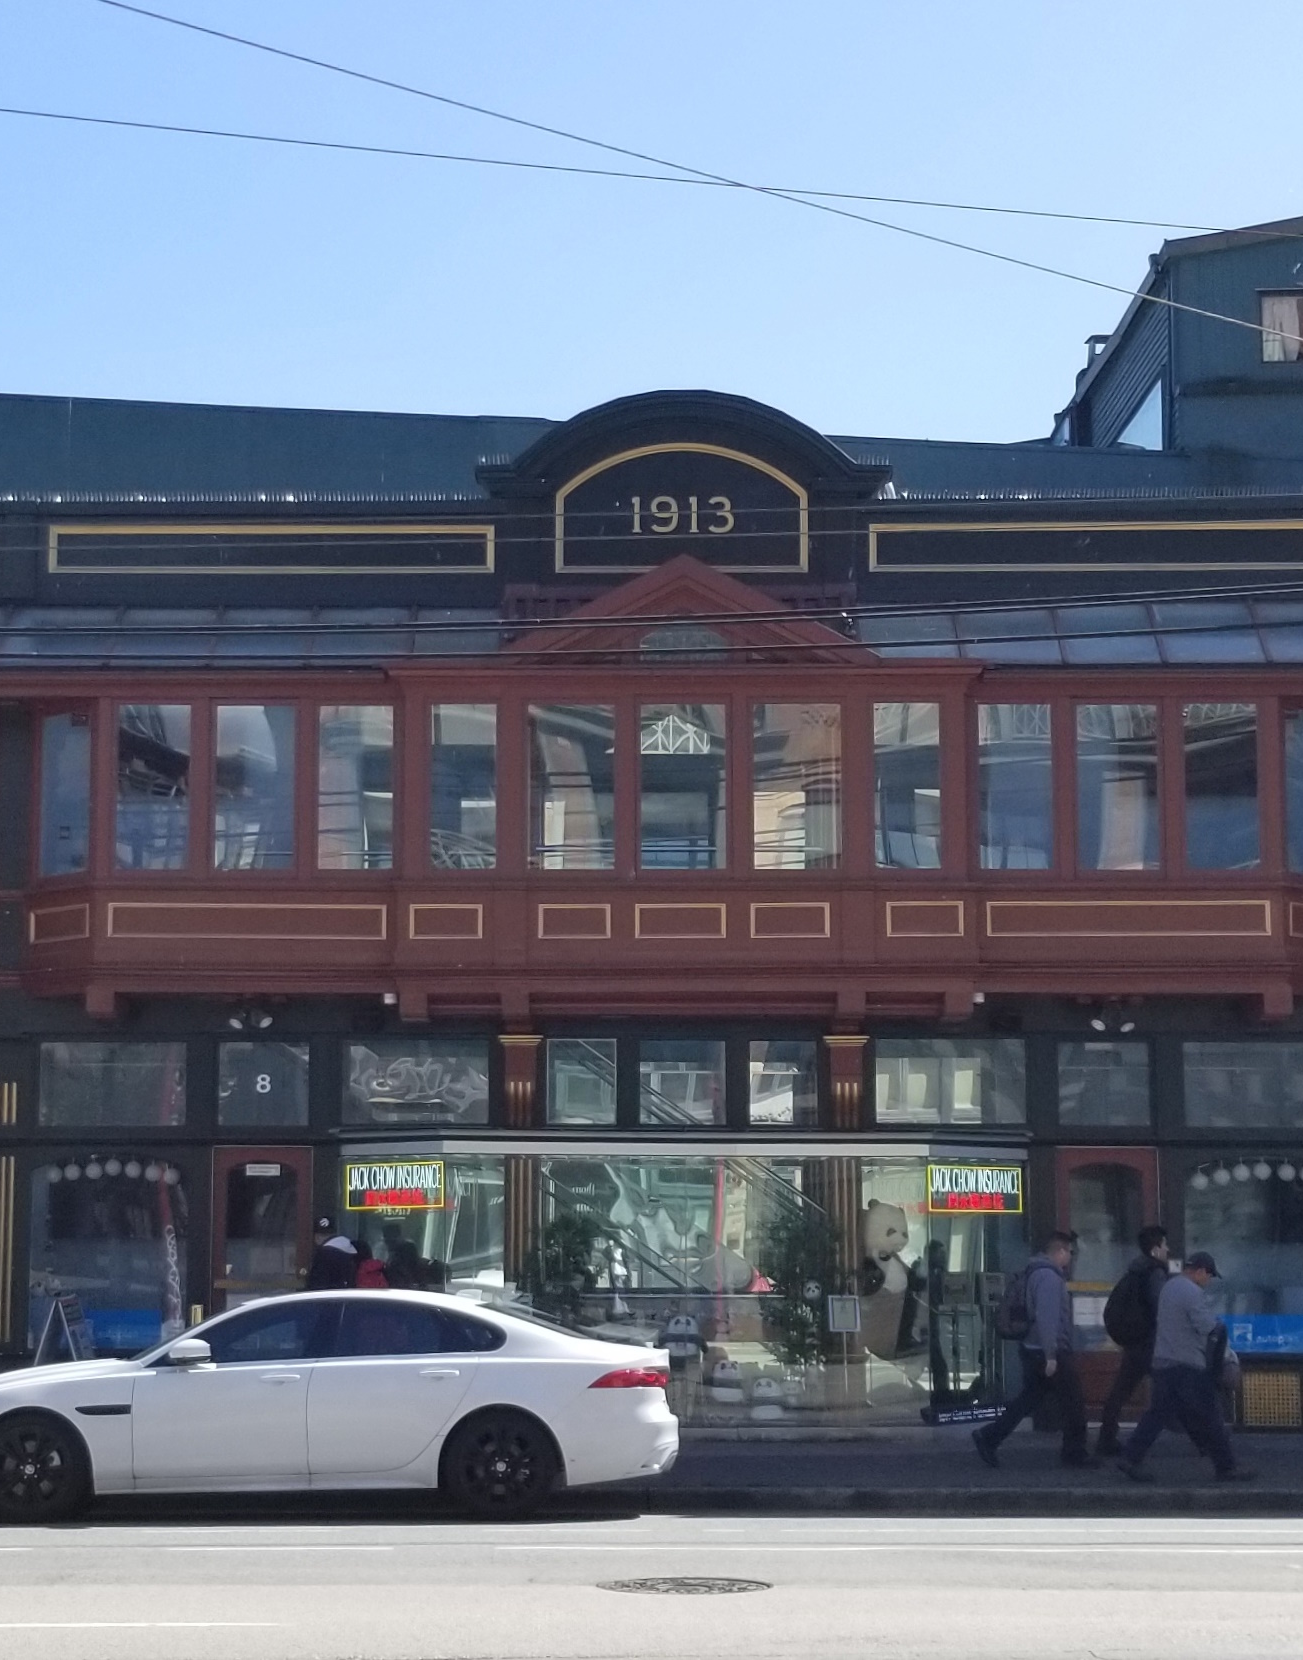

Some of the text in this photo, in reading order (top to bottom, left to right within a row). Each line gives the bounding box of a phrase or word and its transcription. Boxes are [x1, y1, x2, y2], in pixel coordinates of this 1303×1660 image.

[631, 496, 735, 533] 1913
[256, 1073, 272, 1094] 8
[349, 1166, 370, 1190] JACK
[371, 1165, 396, 1190] CHOW
[397, 1164, 442, 1189] INSURANCE
[931, 1168, 1020, 1194] JACK CHOW INSURANCE
